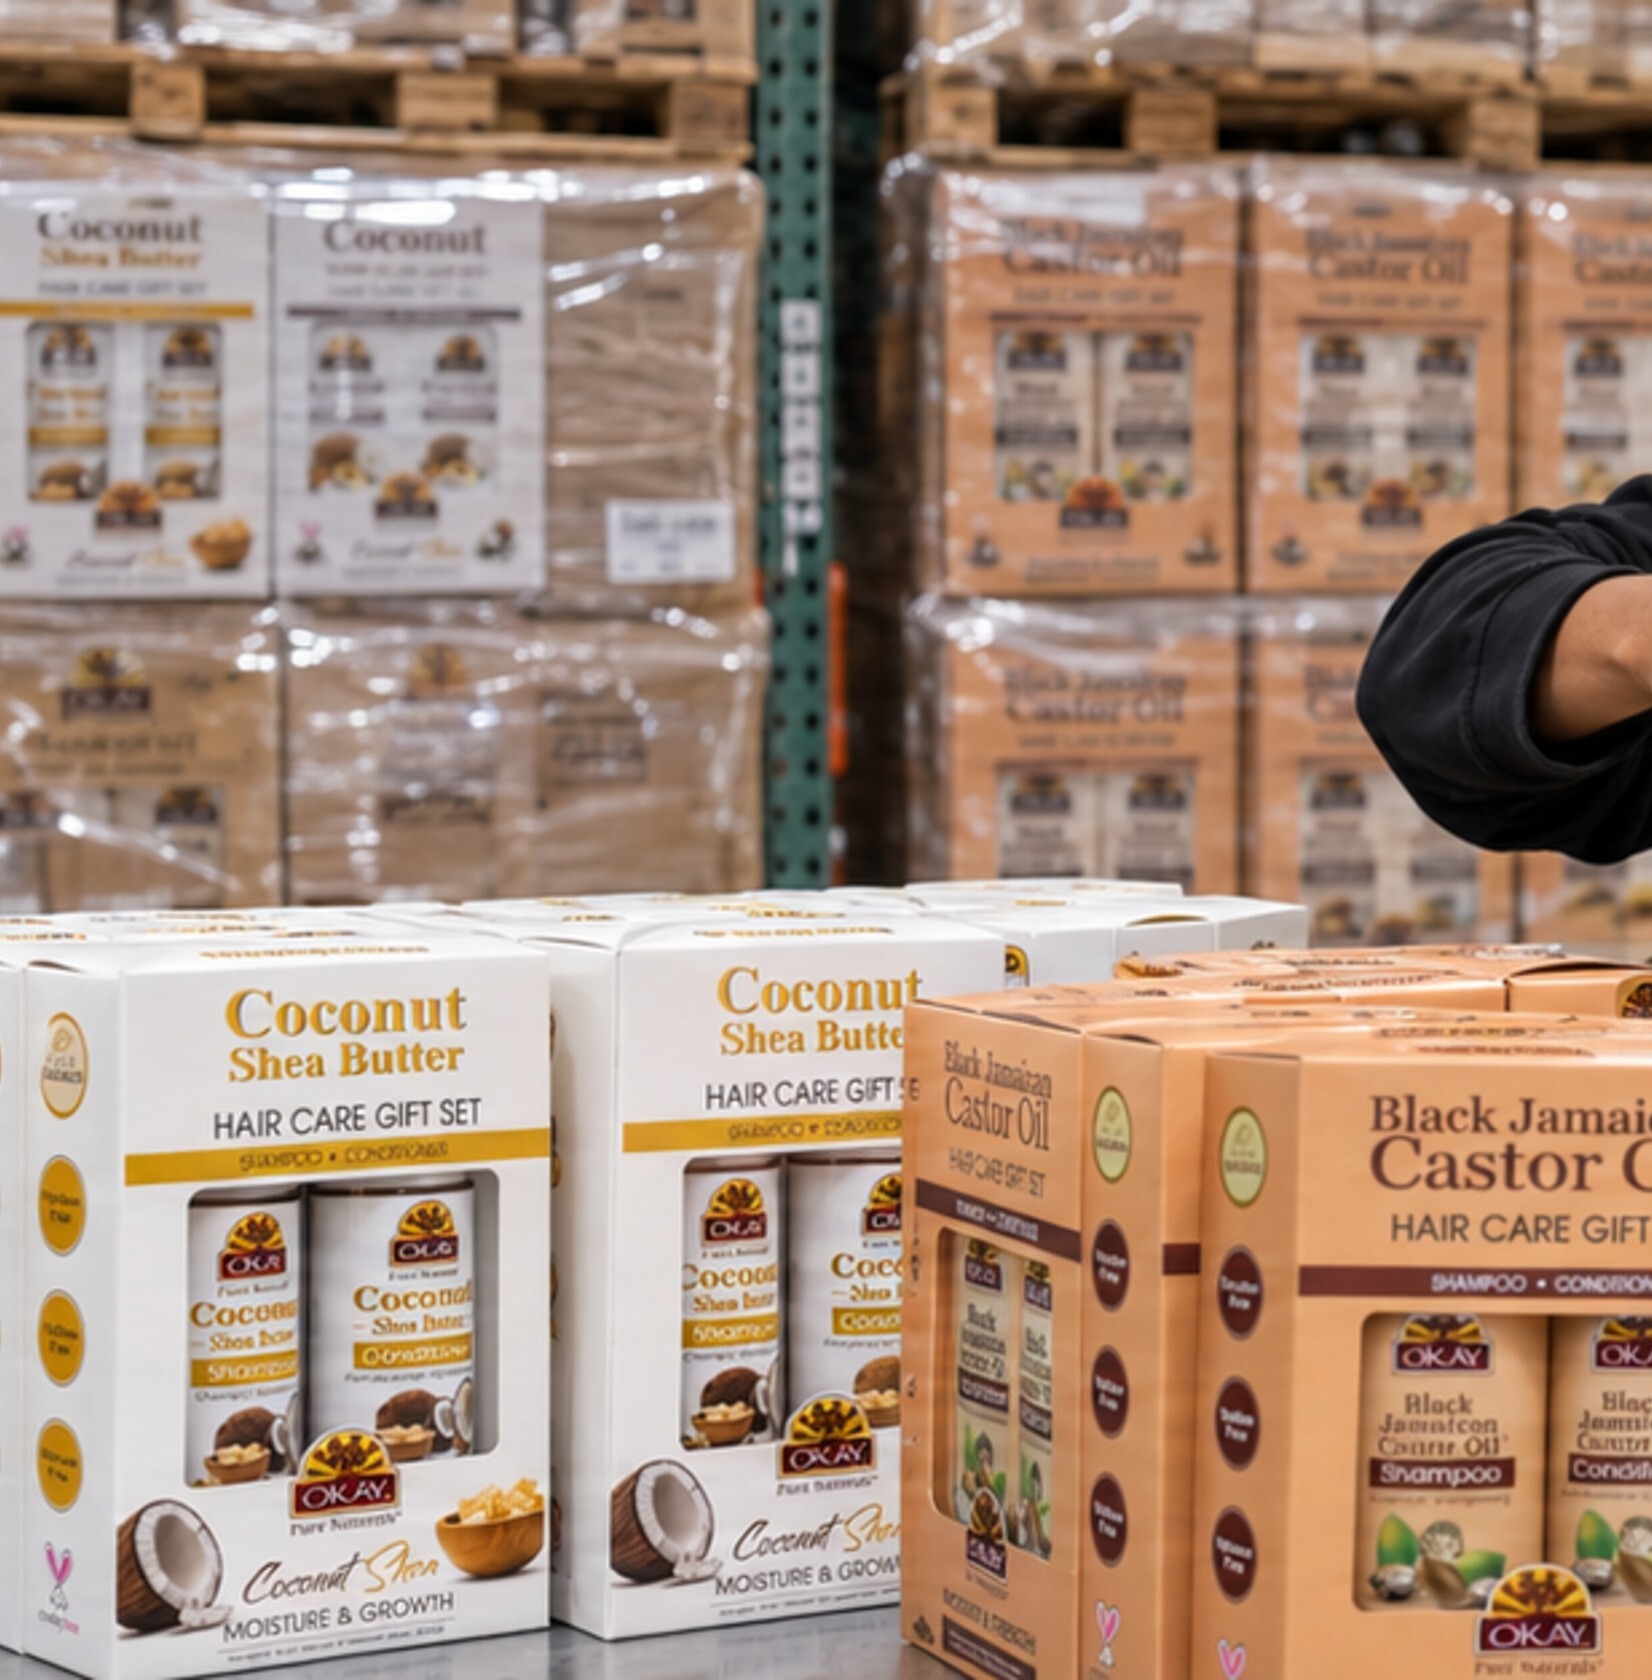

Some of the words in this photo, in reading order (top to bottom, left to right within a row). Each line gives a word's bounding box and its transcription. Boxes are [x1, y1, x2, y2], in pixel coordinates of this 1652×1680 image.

[38, 211, 203, 243] Coconut
[324, 219, 487, 253] Coconut
[1310, 253, 1409, 284] Castor
[717, 967, 922, 1015] Coconut
[225, 986, 467, 1039] Coconut
[721, 1020, 805, 1056] Shea
[817, 1019, 904, 1052] Butte
[228, 1046, 326, 1082] Shea
[339, 1041, 465, 1077] Butter
[705, 1080, 767, 1112] HAIR
[774, 1077, 838, 1107] CARE
[846, 1075, 894, 1103] GIFT
[214, 1108, 282, 1140] HAIR
[290, 1104, 366, 1136] CARE
[376, 1101, 432, 1130] GIFT
[440, 1098, 482, 1126] SET
[946, 1076, 1013, 1139] Castor
[1018, 1097, 1050, 1151] Oil
[1369, 1094, 1498, 1134] Black
[1370, 1135, 1603, 1191] Castor
[1391, 1214, 1470, 1242] HAIR
[1481, 1214, 1570, 1243] CARE
[1582, 1215, 1652, 1244] GIFT
[1431, 1273, 1527, 1293] SHAMPOO
[1402, 1346, 1482, 1367] OKAY
[789, 1441, 869, 1470] OKAY
[1380, 1463, 1501, 1488] Shampoo
[302, 1481, 391, 1509] OKAY
[242, 1552, 360, 1604] Coconut
[715, 1566, 813, 1596] MOISTURE
[819, 1564, 832, 1583] &
[838, 1555, 901, 1581] GROW
[222, 1606, 331, 1643] MOISTURE
[338, 1605, 353, 1625] &
[359, 1592, 454, 1622] GROWTH
[1488, 1622, 1590, 1647] OKAY
